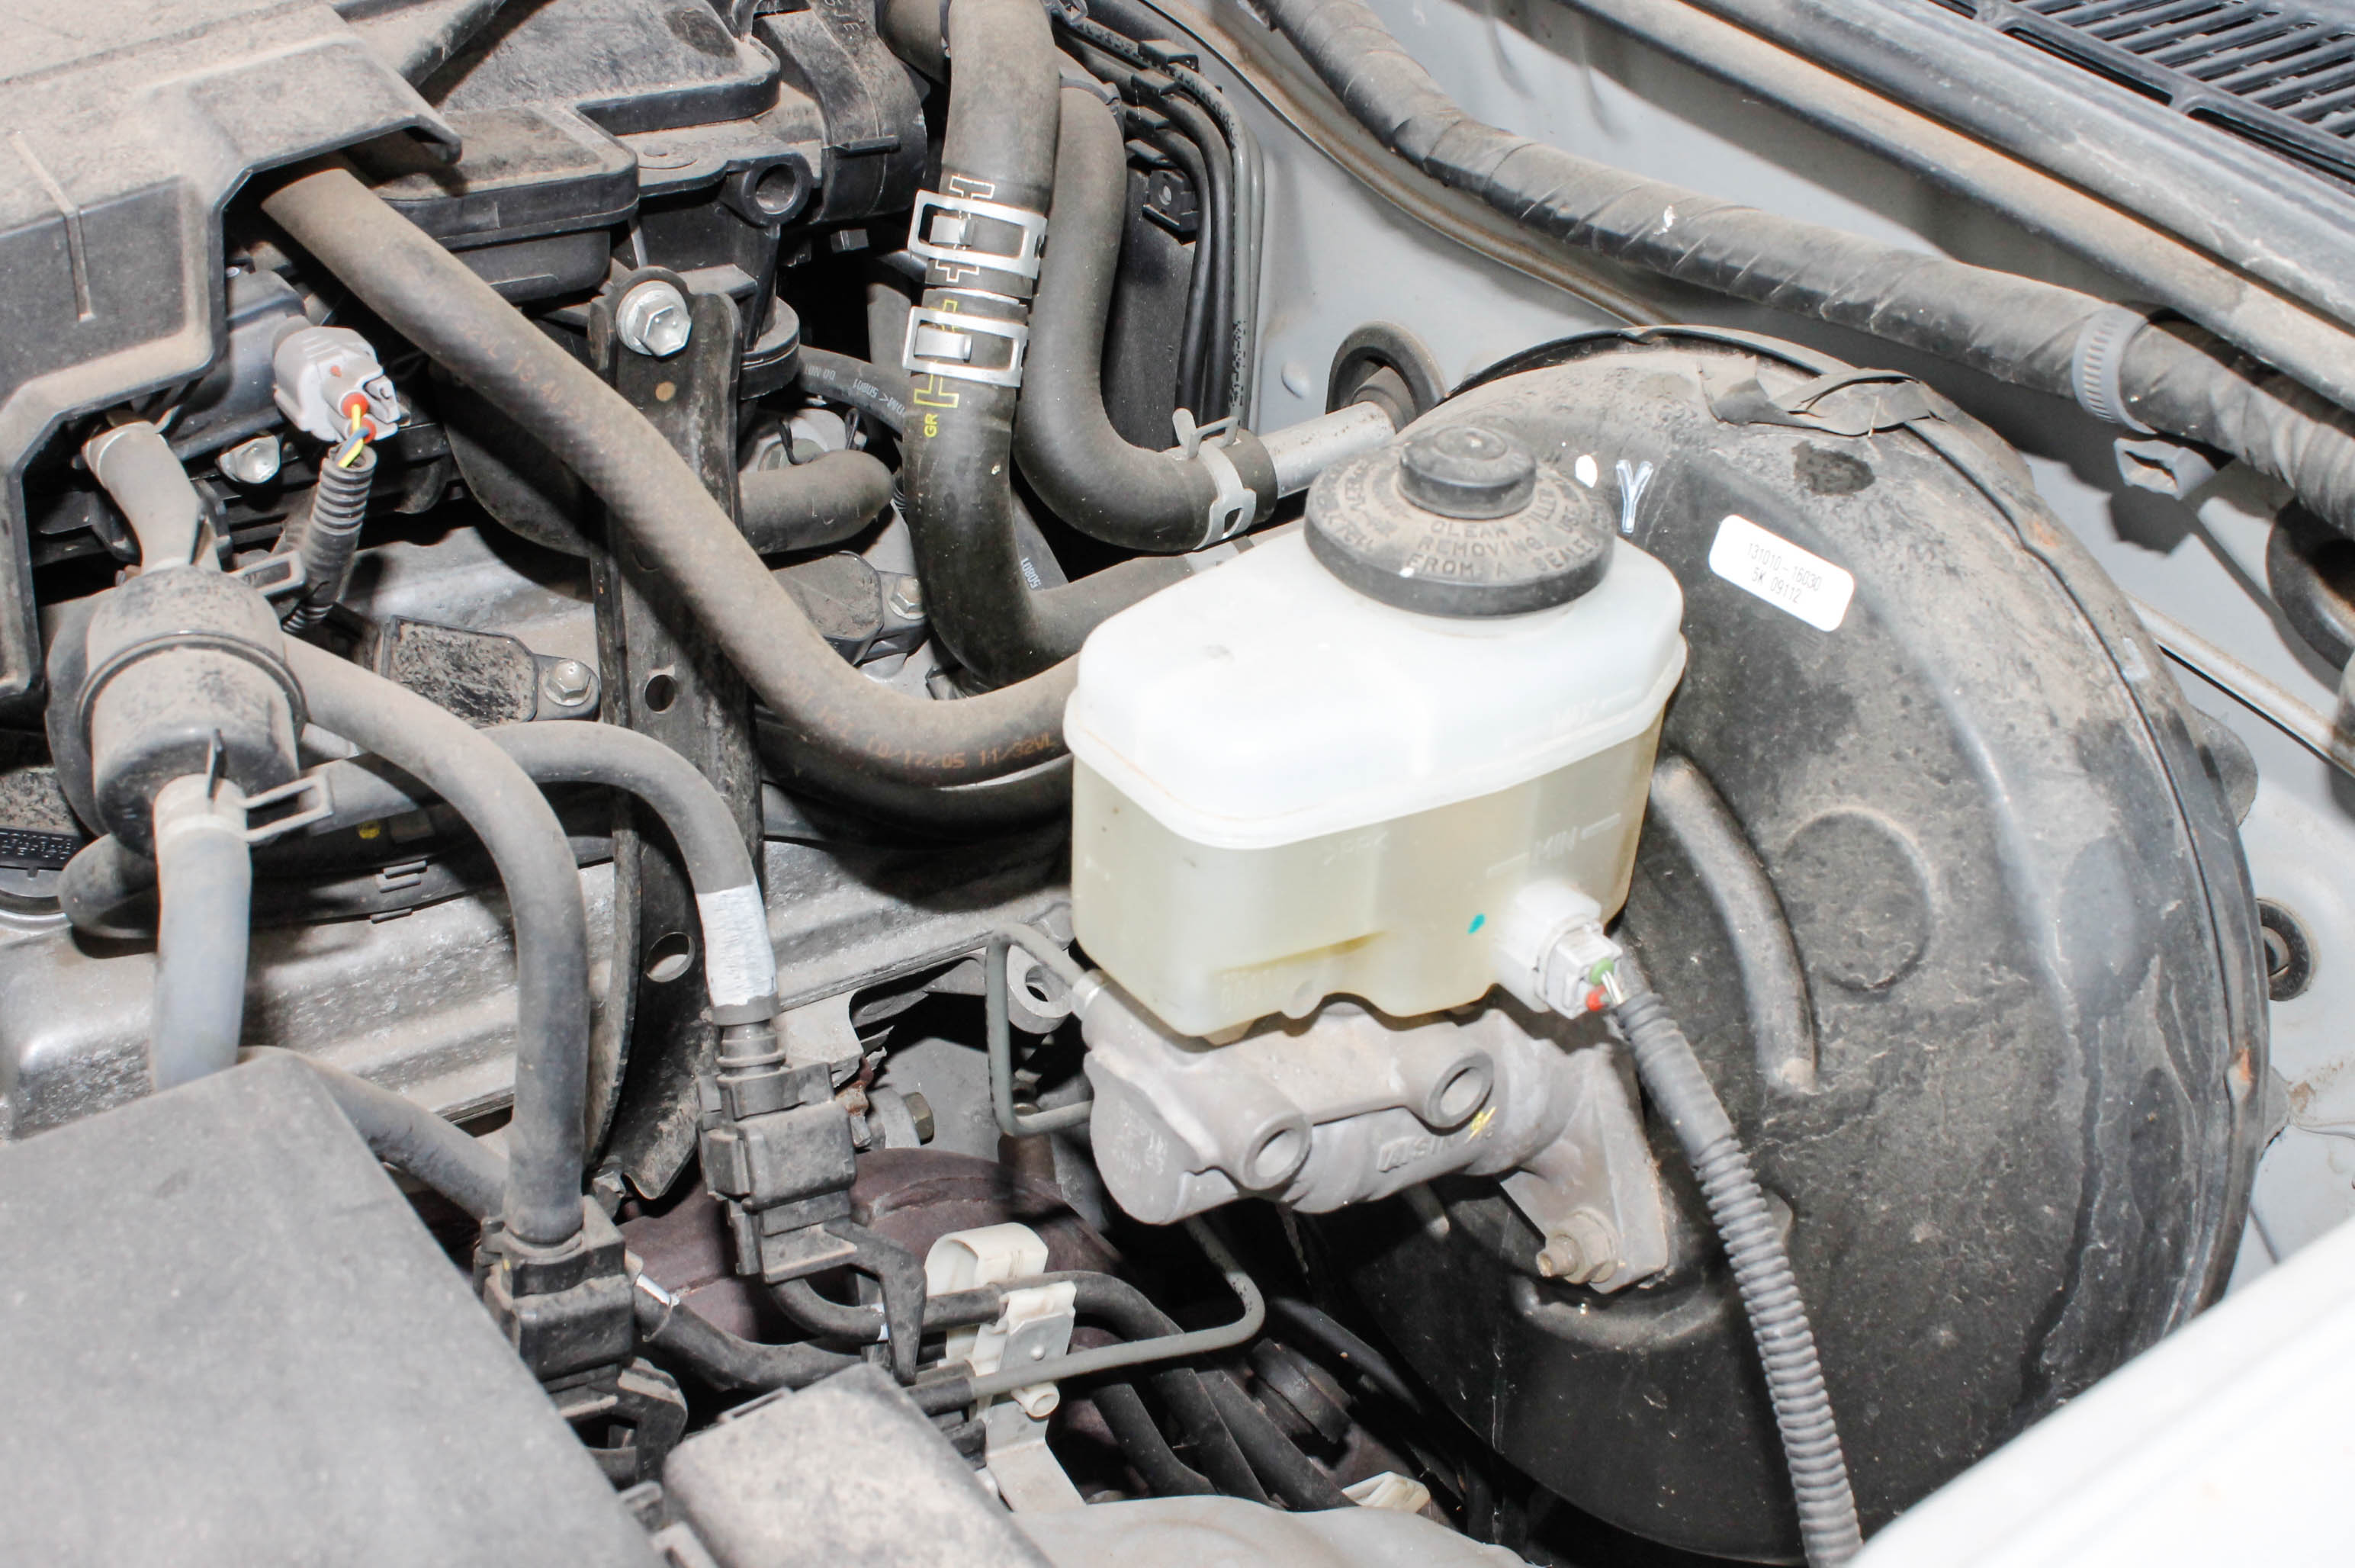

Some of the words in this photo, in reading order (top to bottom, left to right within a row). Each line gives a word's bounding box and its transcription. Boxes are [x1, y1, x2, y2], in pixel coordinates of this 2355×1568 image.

[924, 413, 939, 438] GR
[1430, 519, 1509, 538] CLEAN
[1406, 553, 1474, 577] FROM
[1534, 826, 1579, 865] MIN
